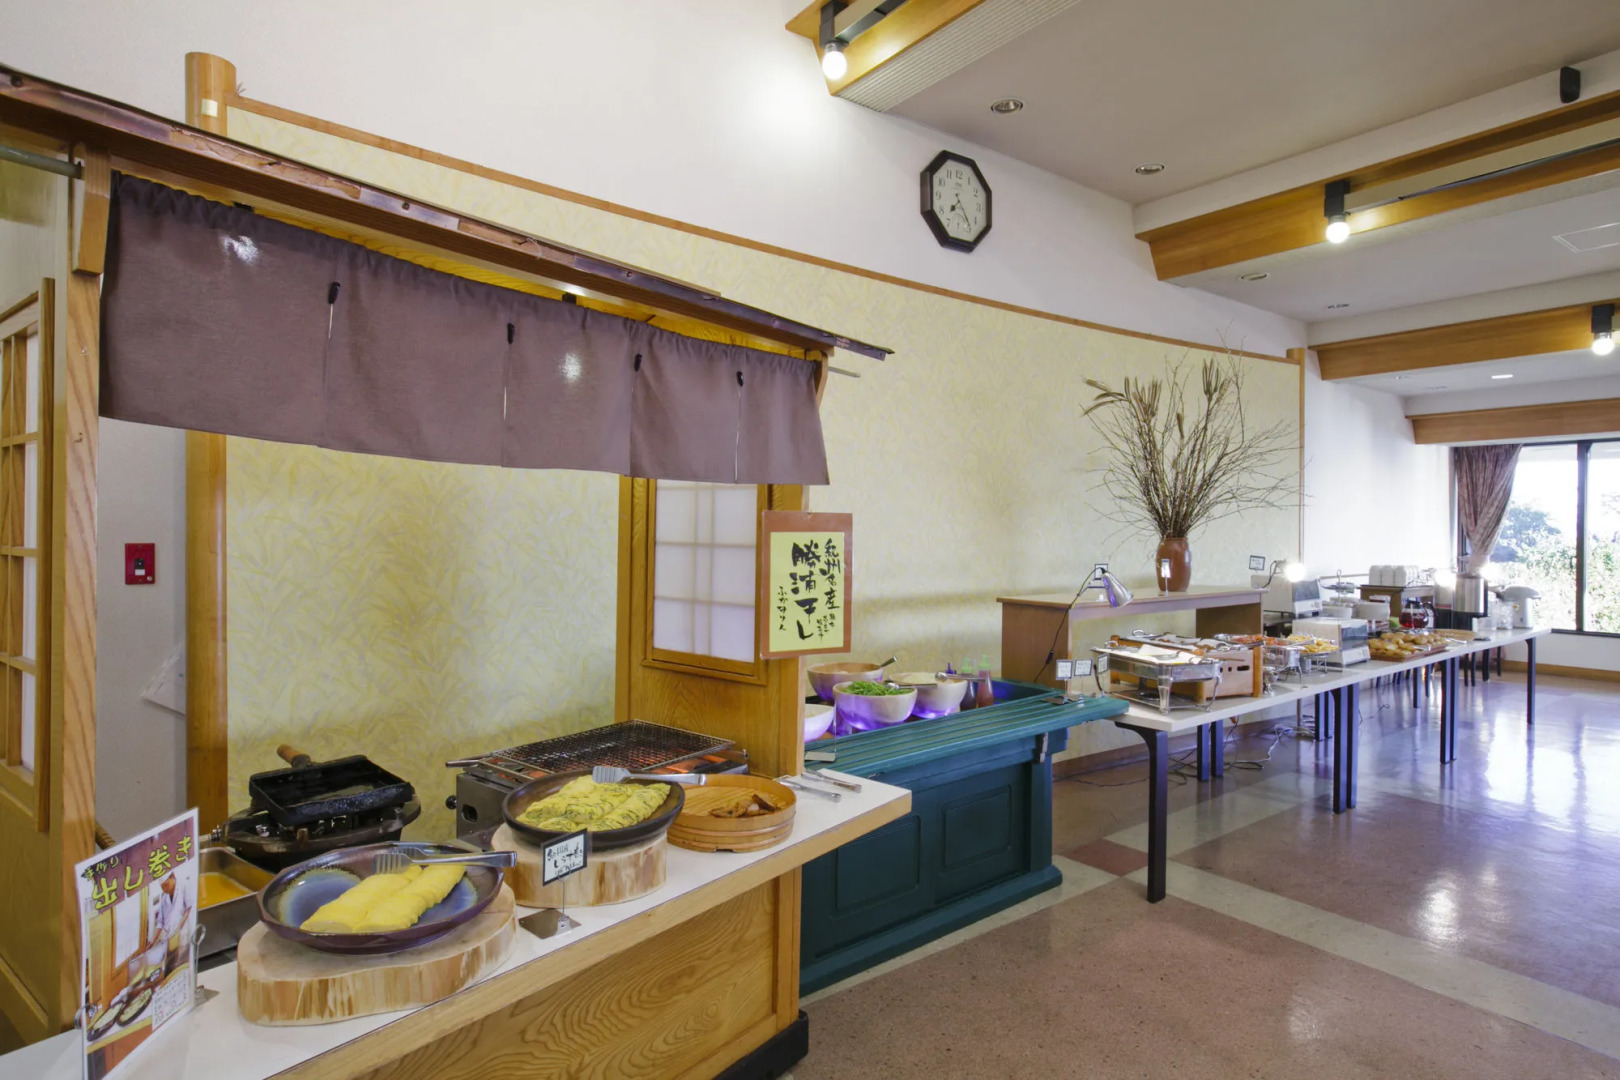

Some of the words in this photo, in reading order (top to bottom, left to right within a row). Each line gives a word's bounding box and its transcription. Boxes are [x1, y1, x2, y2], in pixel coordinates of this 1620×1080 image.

[955, 169, 963, 179] 12
[938, 178, 946, 187] 10
[936, 191, 941, 200] 9
[973, 188, 979, 198] 2
[939, 205, 945, 215] 8
[946, 217, 951, 227] 7
[83, 855, 119, 881] 手作り
[92, 836, 192, 910] 出し巻き
